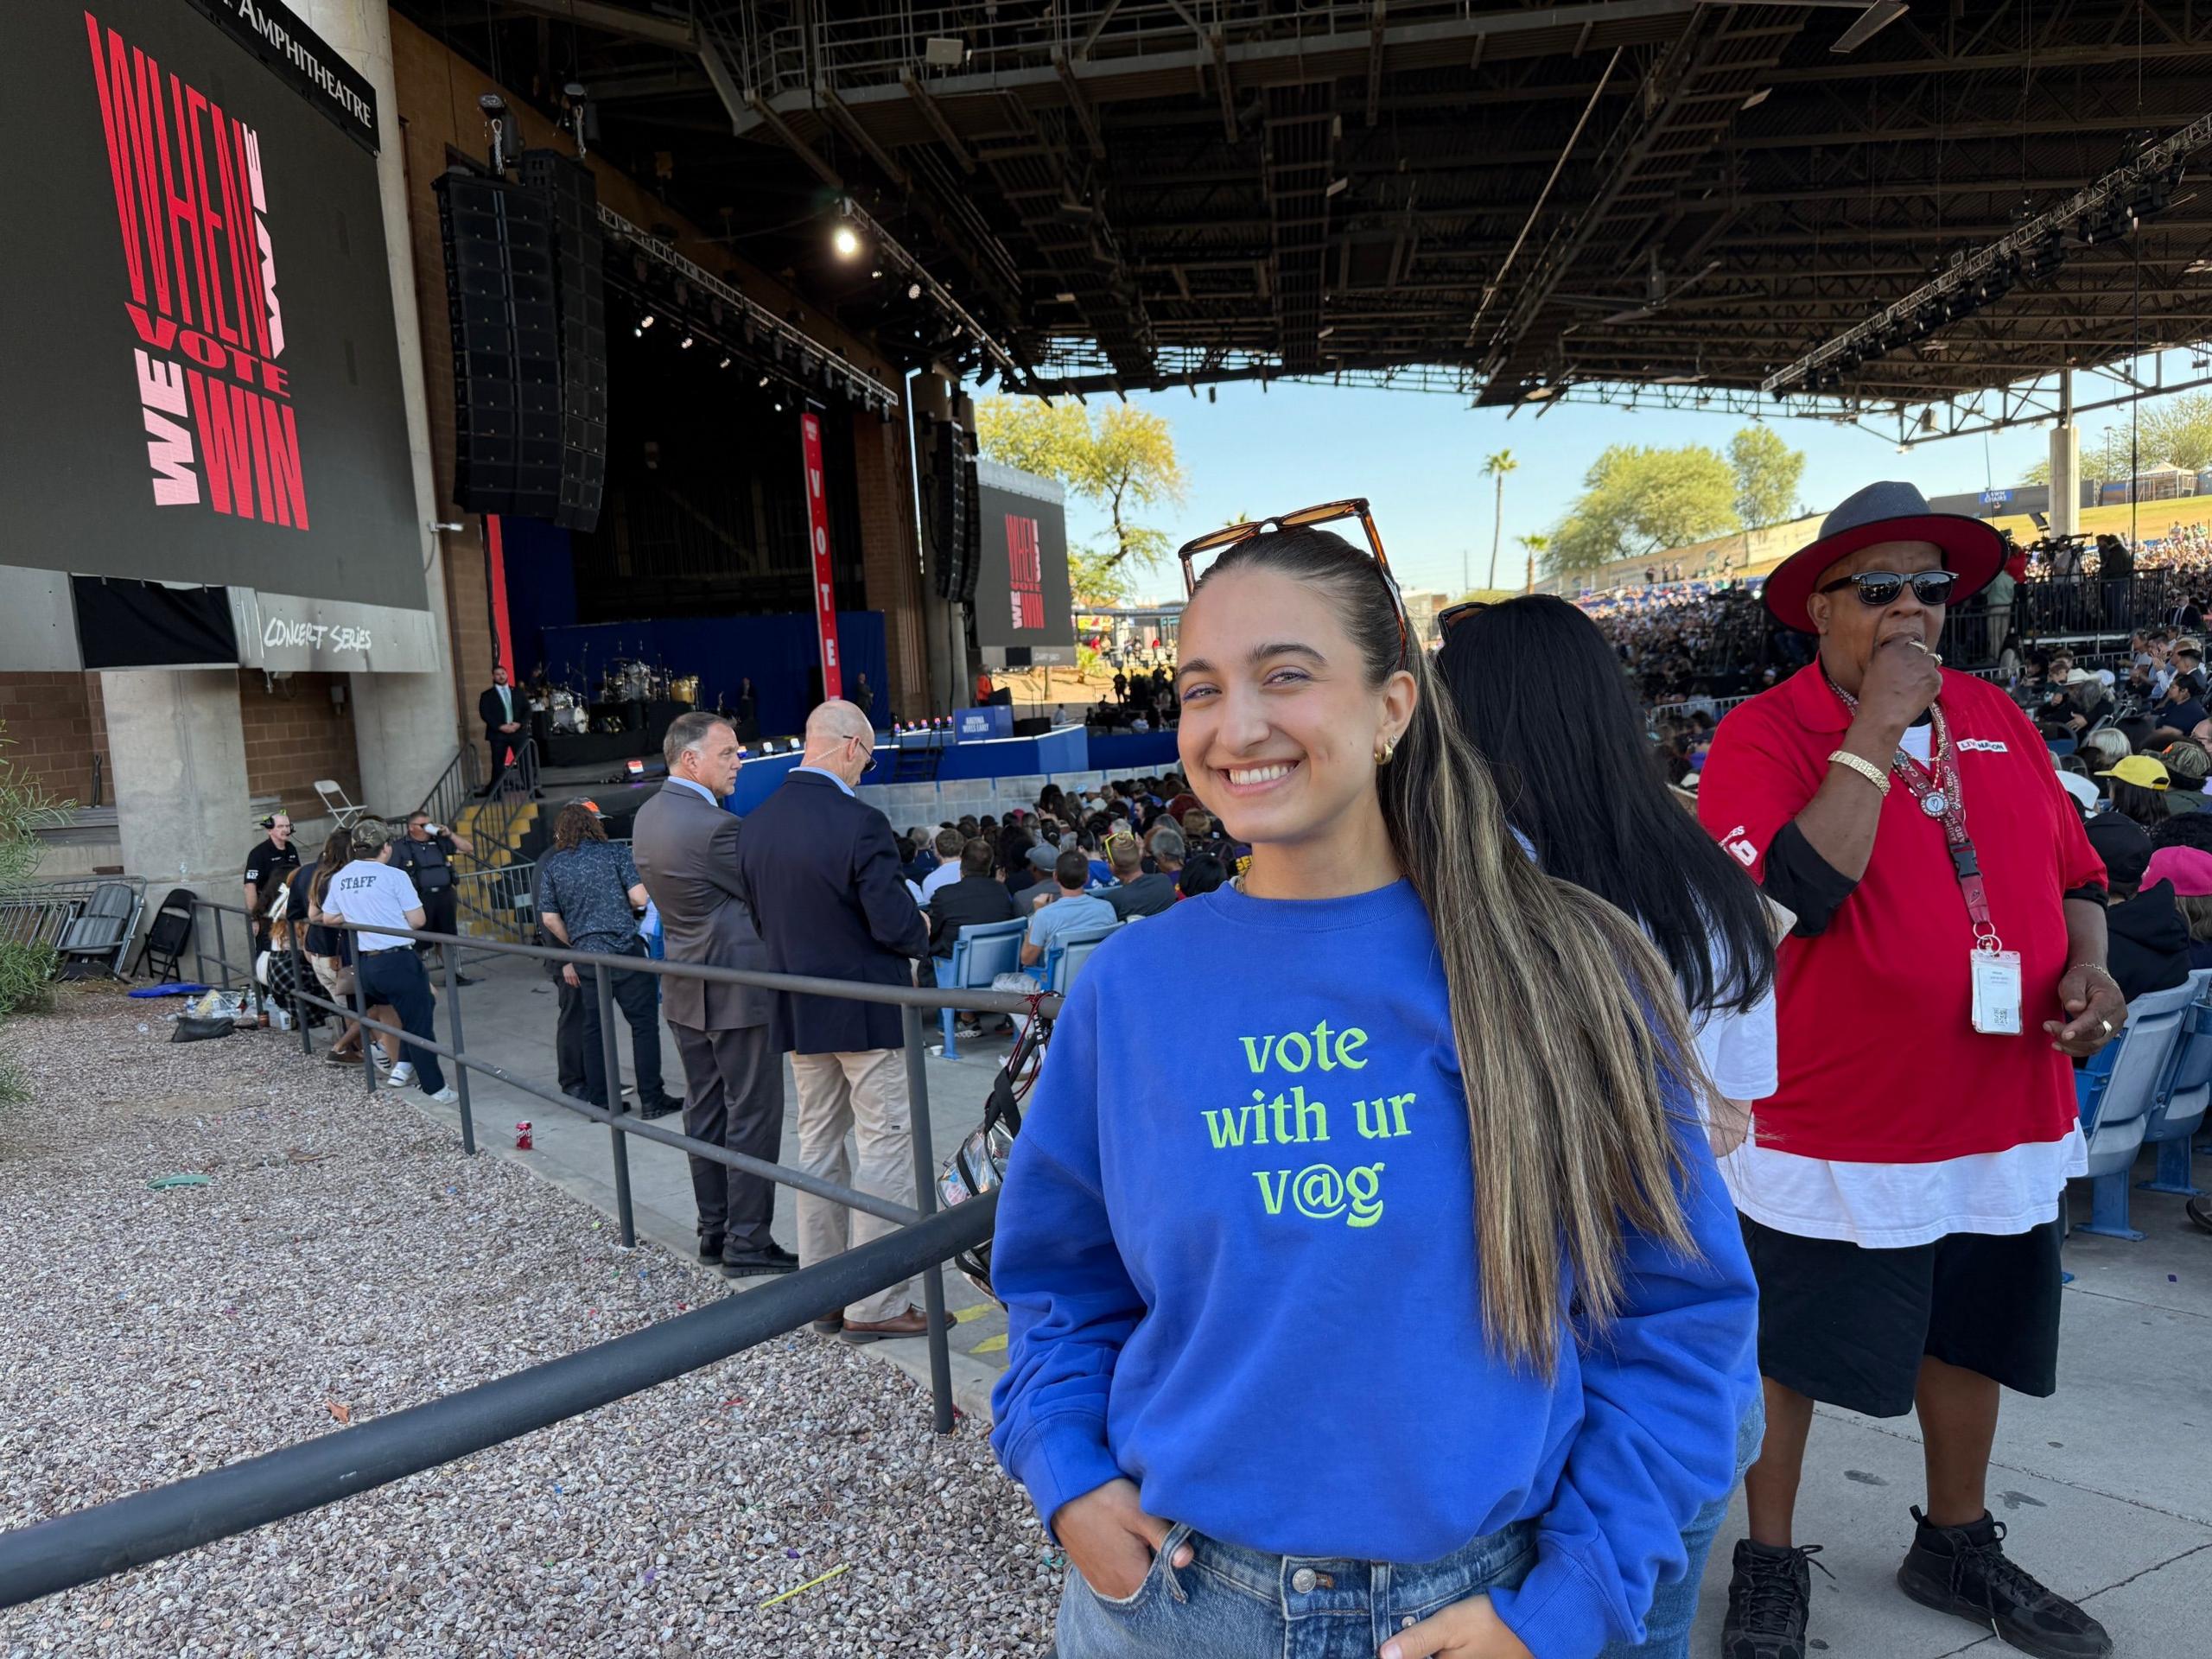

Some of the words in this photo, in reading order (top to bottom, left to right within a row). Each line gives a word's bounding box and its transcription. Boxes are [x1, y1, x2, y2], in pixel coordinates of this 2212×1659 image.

[238, 0, 372, 129] AMPHITHEATRE
[84, 10, 271, 359] WHEN
[124, 302, 291, 398] VOTE
[133, 347, 200, 505] WE
[186, 367, 309, 531] WIN
[264, 617, 328, 651] CONCERT
[340, 875, 377, 891] STAFF
[1238, 1019, 1369, 1073] vote
[1200, 1085, 1331, 1148] with
[1352, 1092, 1417, 1140] ur
[1252, 1161, 1385, 1228] v@g
